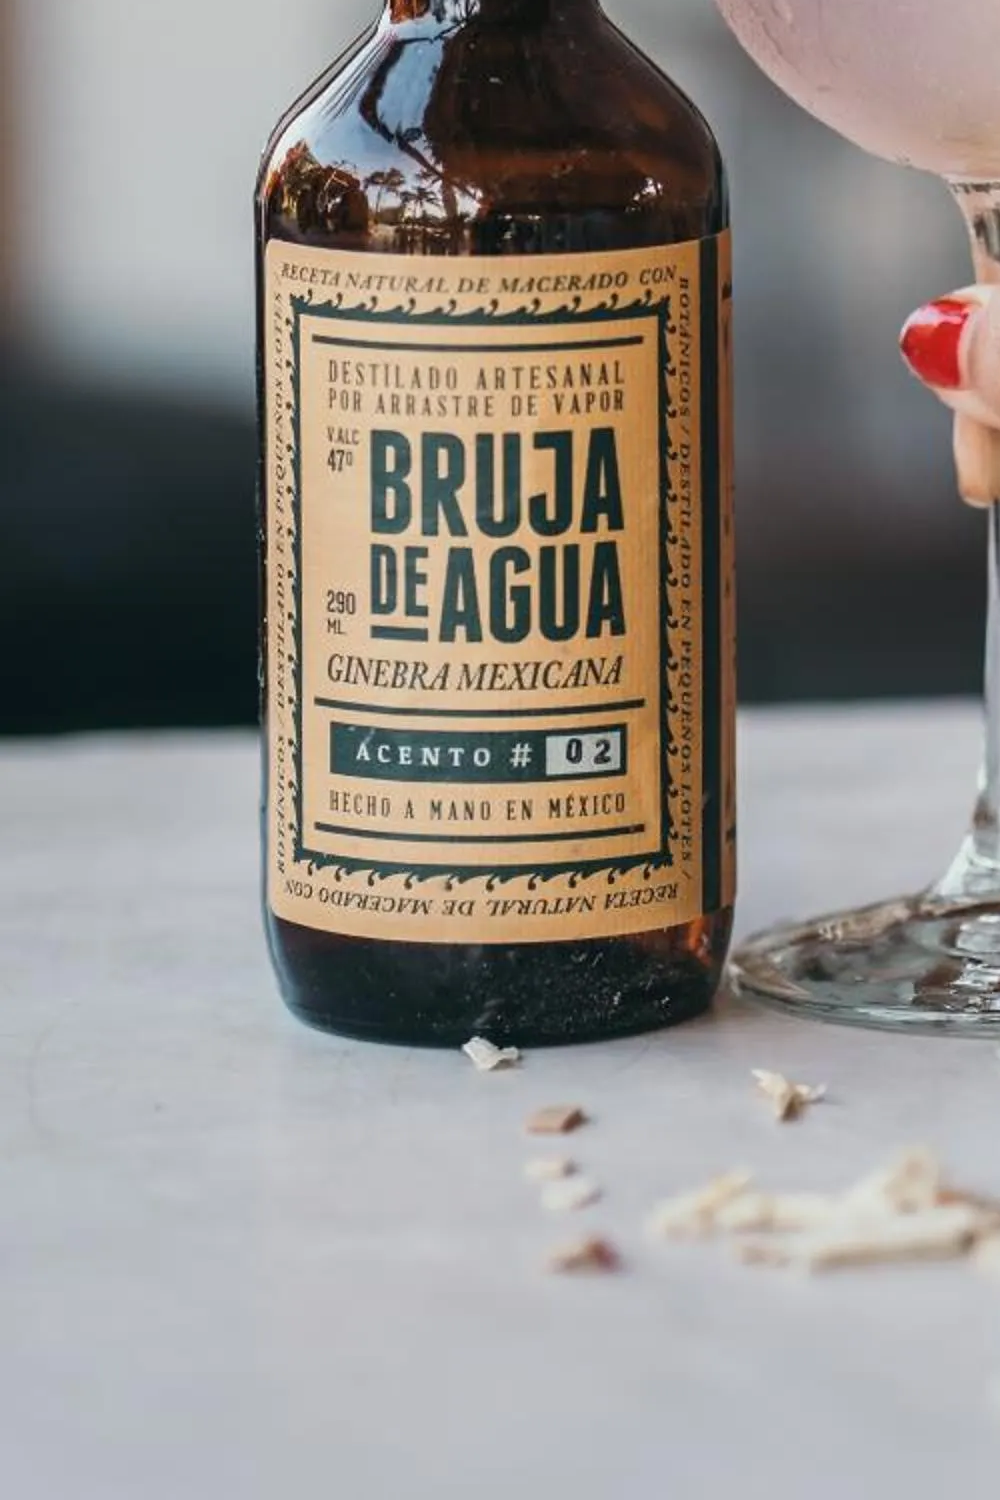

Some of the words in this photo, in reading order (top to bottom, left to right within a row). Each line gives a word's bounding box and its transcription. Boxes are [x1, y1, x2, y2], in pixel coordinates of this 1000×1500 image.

[280, 261, 341, 287] RECETA
[343, 268, 449, 293] NATURAL
[457, 276, 489, 293] DE
[497, 270, 629, 293] MACERADO
[639, 264, 678, 285] CON
[328, 360, 458, 389] DESTILADO
[476, 360, 626, 390] ARTESANAL
[328, 387, 362, 413] POR
[376, 392, 495, 418] ARRASTRE
[510, 393, 538, 417] DE
[553, 389, 625, 415] VAPOR
[369, 426, 625, 539] BRUJA
[679, 443, 693, 589] DESTILADO
[327, 588, 356, 615] 290
[369, 543, 429, 617] DE
[438, 540, 626, 643] AGUA
[680, 599, 693, 631] EN
[327, 653, 451, 691] GINEBRA
[456, 654, 624, 692] MEXICANA
[355, 741, 492, 767] ACENTO
[509, 742, 532, 768] #
[564, 737, 612, 765] 02
[329, 789, 391, 817] HECHO
[403, 799, 415, 819] A
[429, 800, 492, 821] MANO
[506, 799, 533, 821] EN
[549, 791, 626, 819] MÉXICO
[680, 783, 693, 862] LOTES
[283, 878, 312, 899] CON
[318, 888, 434, 915] MACERADO
[604, 883, 679, 911] RECETA
[442, 900, 474, 916] DE
[486, 895, 595, 916] NATURAL
